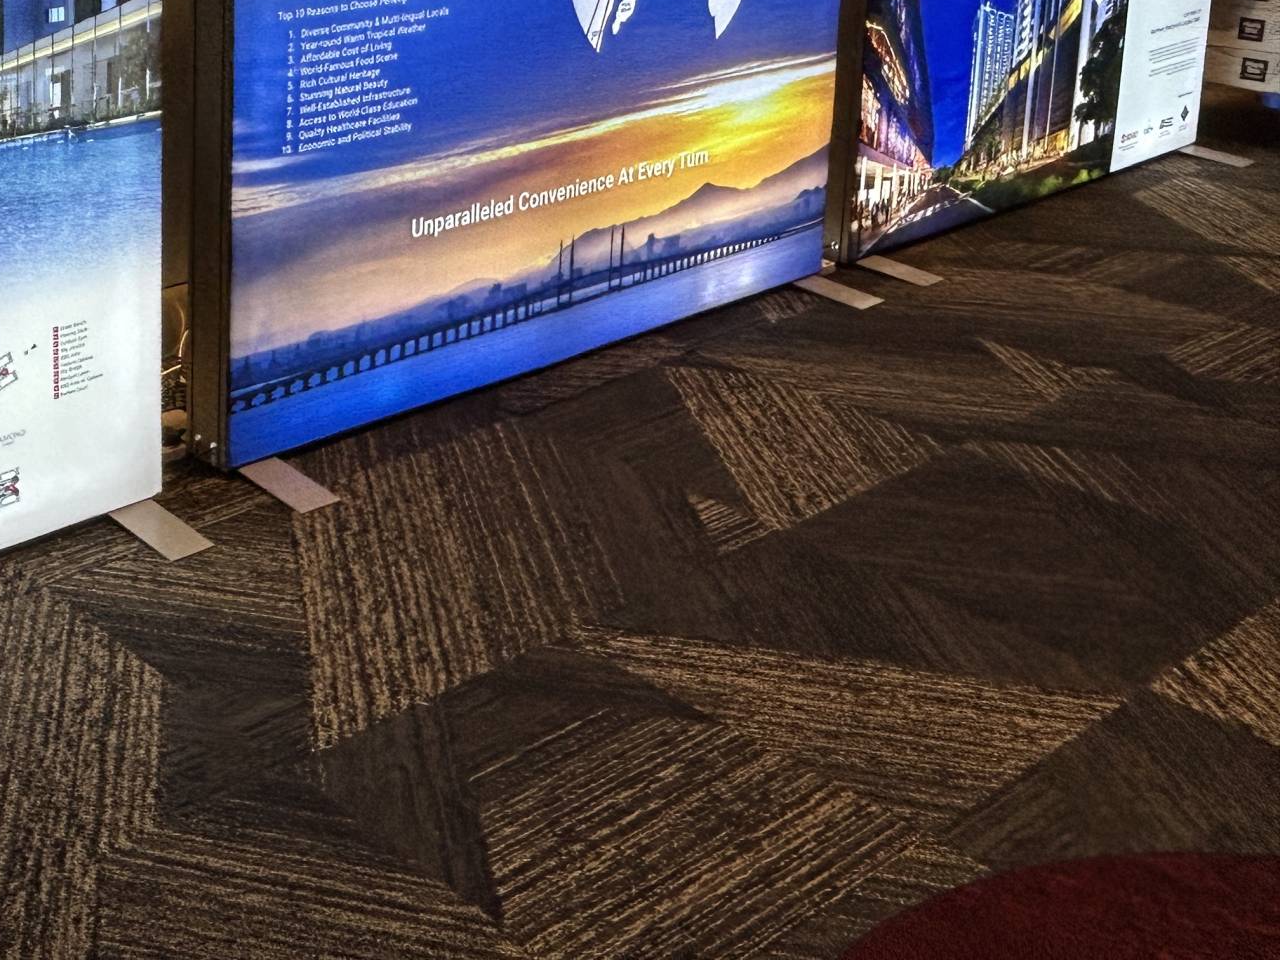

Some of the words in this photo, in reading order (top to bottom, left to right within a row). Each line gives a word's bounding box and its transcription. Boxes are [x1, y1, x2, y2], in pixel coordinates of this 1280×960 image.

[277, 12, 292, 20] Top
[295, 9, 304, 17] 10
[306, 6, 338, 16] Reasons
[340, 3, 347, 11] to
[350, 1, 377, 10] Choose
[300, 27, 328, 37] Diverse
[331, 19, 372, 32] Community
[300, 36, 341, 50] Year-round
[367, 27, 395, 39] Tropical
[300, 49, 339, 63] Affordable
[342, 46, 358, 56] Cost
[360, 43, 368, 52] of
[370, 41, 391, 51] Living
[355, 55, 374, 66] Food
[376, 53, 397, 62] Scene
[299, 89, 332, 101] Stunning
[334, 82, 361, 95] Natural
[363, 78, 387, 89] Beauty
[300, 77, 316, 88] Rich
[318, 73, 346, 85] Cultural
[349, 69, 380, 79] Heritage
[298, 116, 325, 127] Access
[328, 112, 336, 121] to
[383, 97, 417, 110] Education
[298, 127, 324, 139] Quality
[326, 120, 366, 133] Healthcare
[368, 112, 399, 124] Facilities
[298, 137, 335, 152] Economic
[337, 133, 350, 143] and
[352, 127, 381, 140] Political
[411, 195, 514, 238] Unparalleled
[518, 173, 614, 211] Convenience
[618, 165, 634, 185] At
[637, 158, 676, 182] Every
[679, 150, 710, 170] Turn
